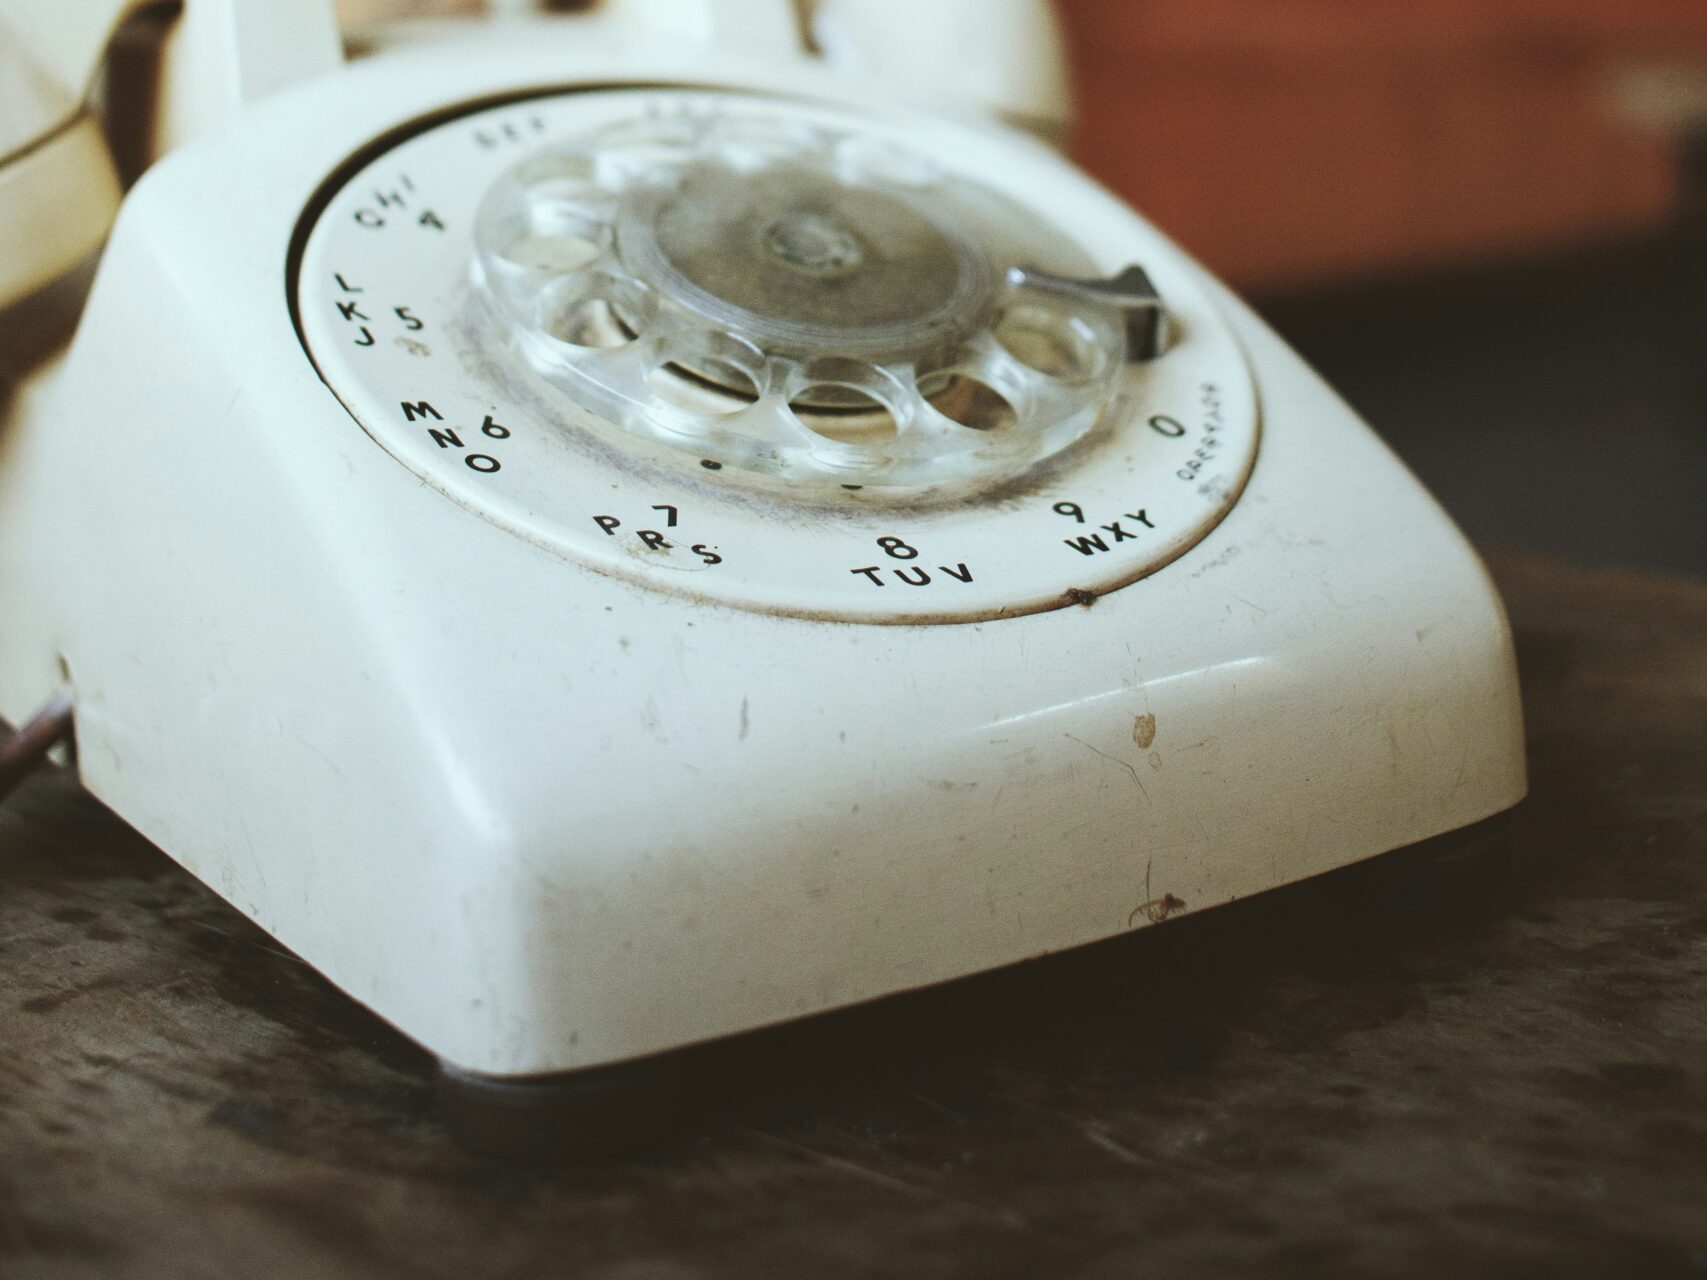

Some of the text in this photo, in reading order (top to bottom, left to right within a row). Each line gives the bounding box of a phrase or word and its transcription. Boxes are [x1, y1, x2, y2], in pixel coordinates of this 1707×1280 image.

[394, 307, 423, 330] 5
[481, 415, 511, 439] 6
[652, 505, 677, 527] 7
[1052, 501, 1085, 523] 9
[1063, 509, 1155, 556] WXY
[877, 536, 918, 560] 8
[850, 563, 974, 586] TUV
